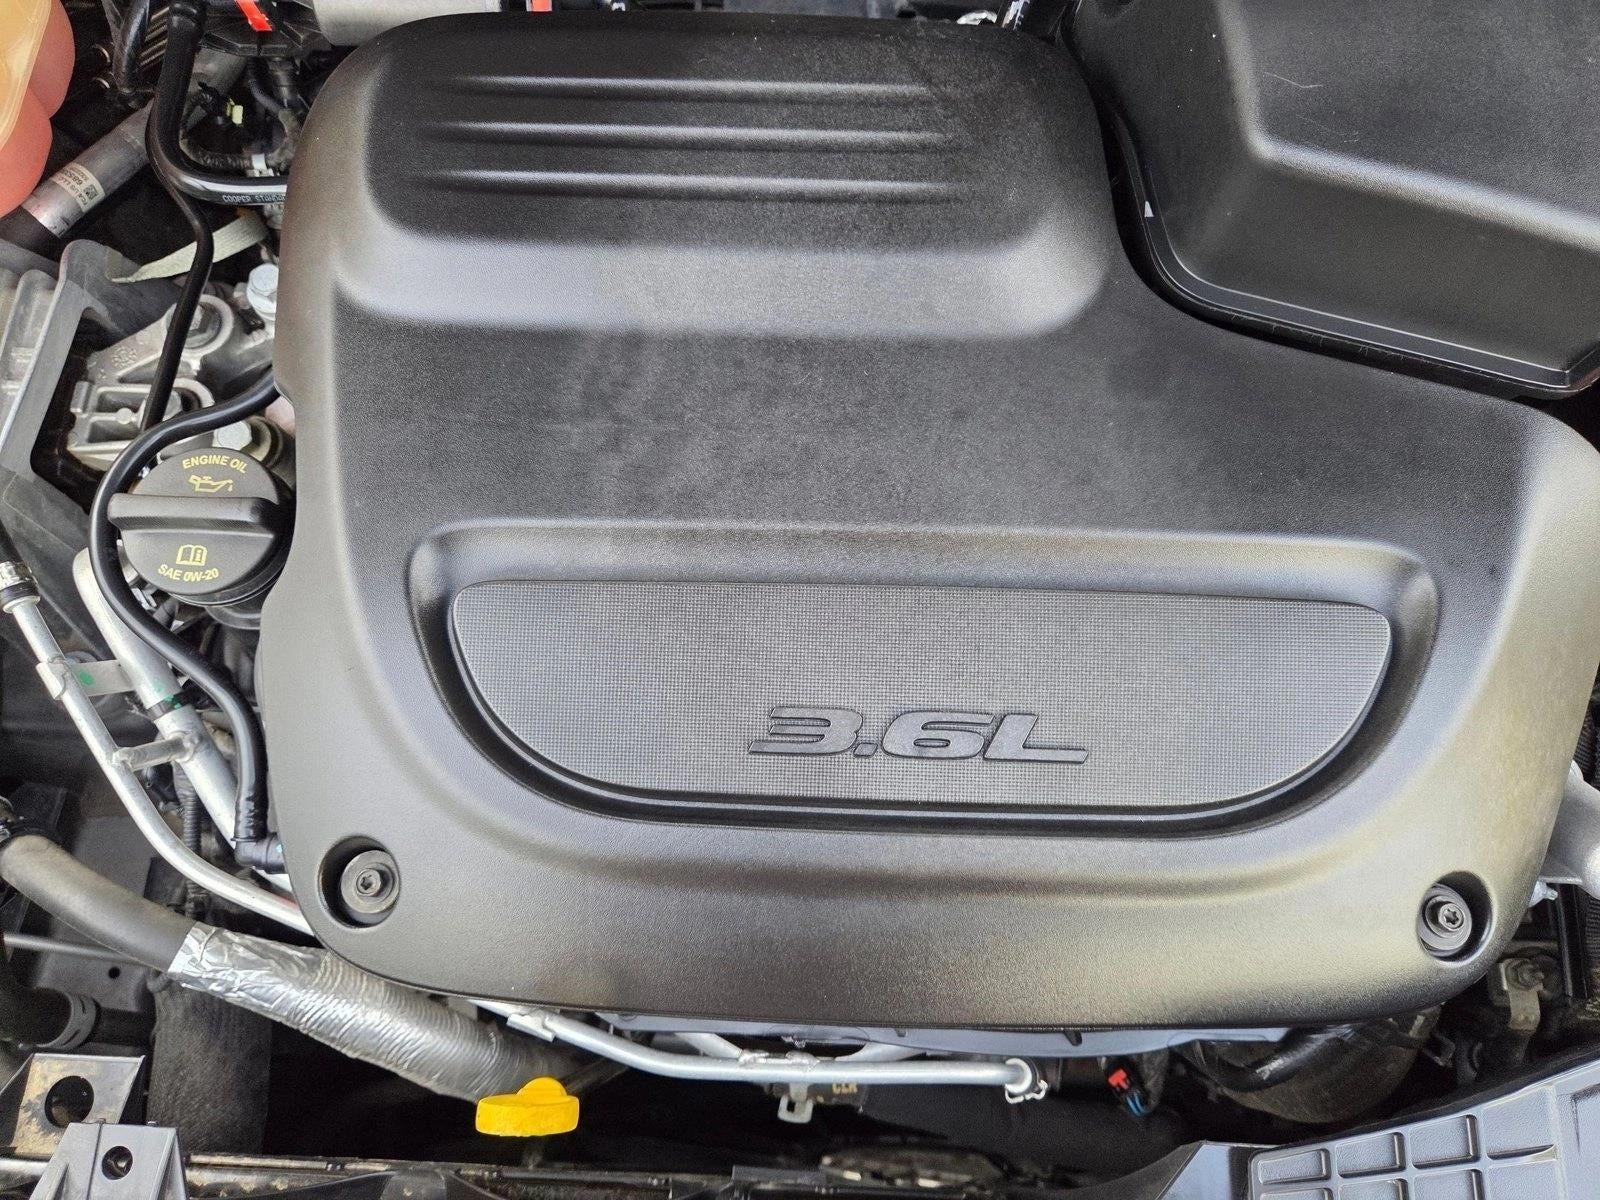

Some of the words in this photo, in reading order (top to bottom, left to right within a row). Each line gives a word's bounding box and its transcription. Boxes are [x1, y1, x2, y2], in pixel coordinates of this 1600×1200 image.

[182, 454, 230, 470] ENGINE
[230, 458, 248, 474] OIL
[158, 563, 183, 581] SAE
[183, 567, 220, 582] 0W-20
[748, 705, 1090, 764] 3.6L
